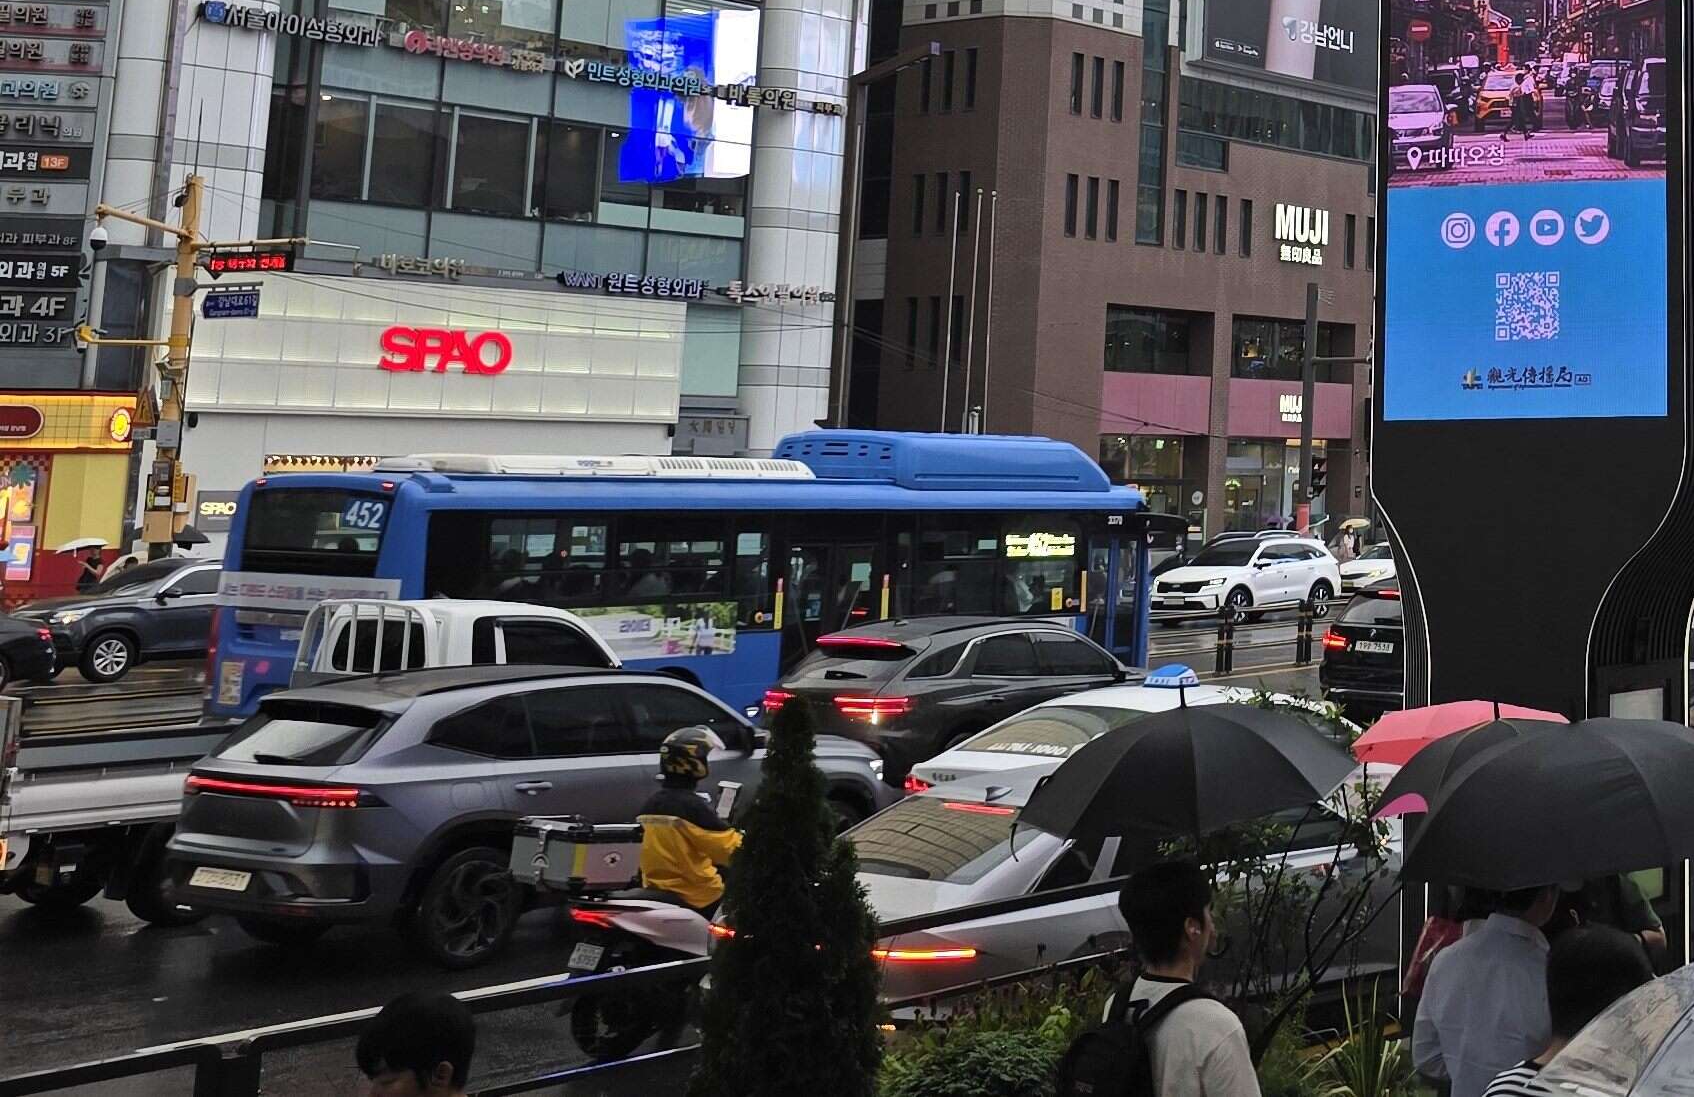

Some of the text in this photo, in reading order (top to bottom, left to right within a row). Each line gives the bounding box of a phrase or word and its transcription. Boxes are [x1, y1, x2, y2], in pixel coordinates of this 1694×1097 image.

[226, 4, 386, 47] 서울아이성형외과
[1300, 20, 1354, 53] 강남언니
[588, 61, 702, 97] 민트성형외과의원
[44, 157, 66, 168] 13F
[1275, 203, 1329, 245] MUJI
[22, 233, 61, 245] 피부과
[50, 265, 69, 278] 5F
[607, 272, 702, 299] 원트성형외과
[30, 297, 66, 316] 4F
[379, 325, 512, 375] SPAO
[200, 501, 237, 516] SPAO
[345, 500, 384, 529] 452
